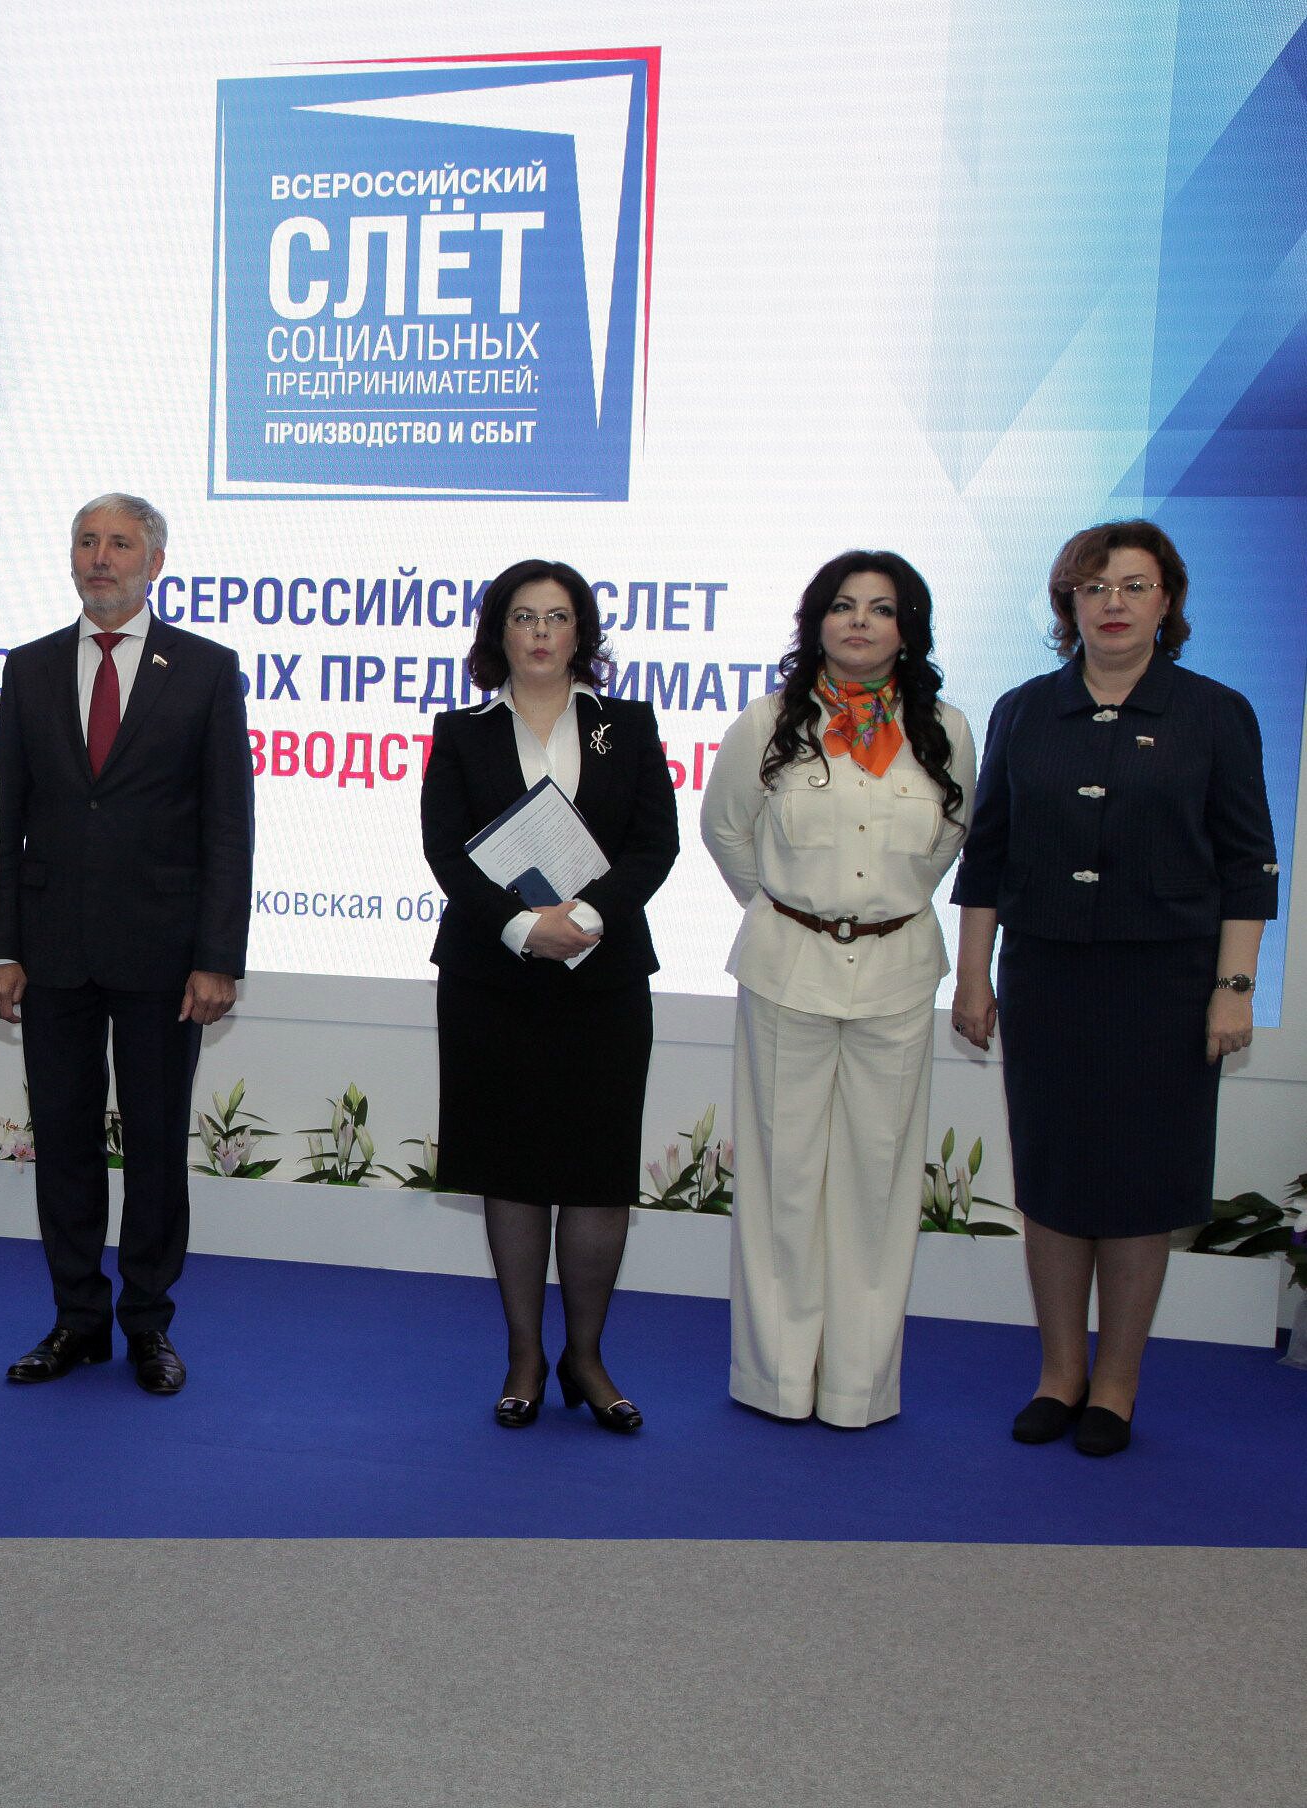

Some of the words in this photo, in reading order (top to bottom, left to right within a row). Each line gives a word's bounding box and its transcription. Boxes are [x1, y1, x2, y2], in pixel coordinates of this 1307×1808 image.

[270, 160, 547, 199] ВСЕРОССИЙСКИЙ
[268, 198, 545, 320] СЛЁТ
[266, 322, 541, 369] СОЦИАЛЬНЫХ
[265, 364, 540, 400] ПРЕДПРИНИМАТЕЛЕЙ:
[264, 422, 442, 447] ПРОИЗВОДСТВО
[448, 421, 464, 444] И
[470, 421, 537, 444] СБЫТ
[147, 566, 494, 628] СЕРОССИЙСК
[591, 580, 729, 632] СЛЕТ
[250, 890, 383, 920] ковская
